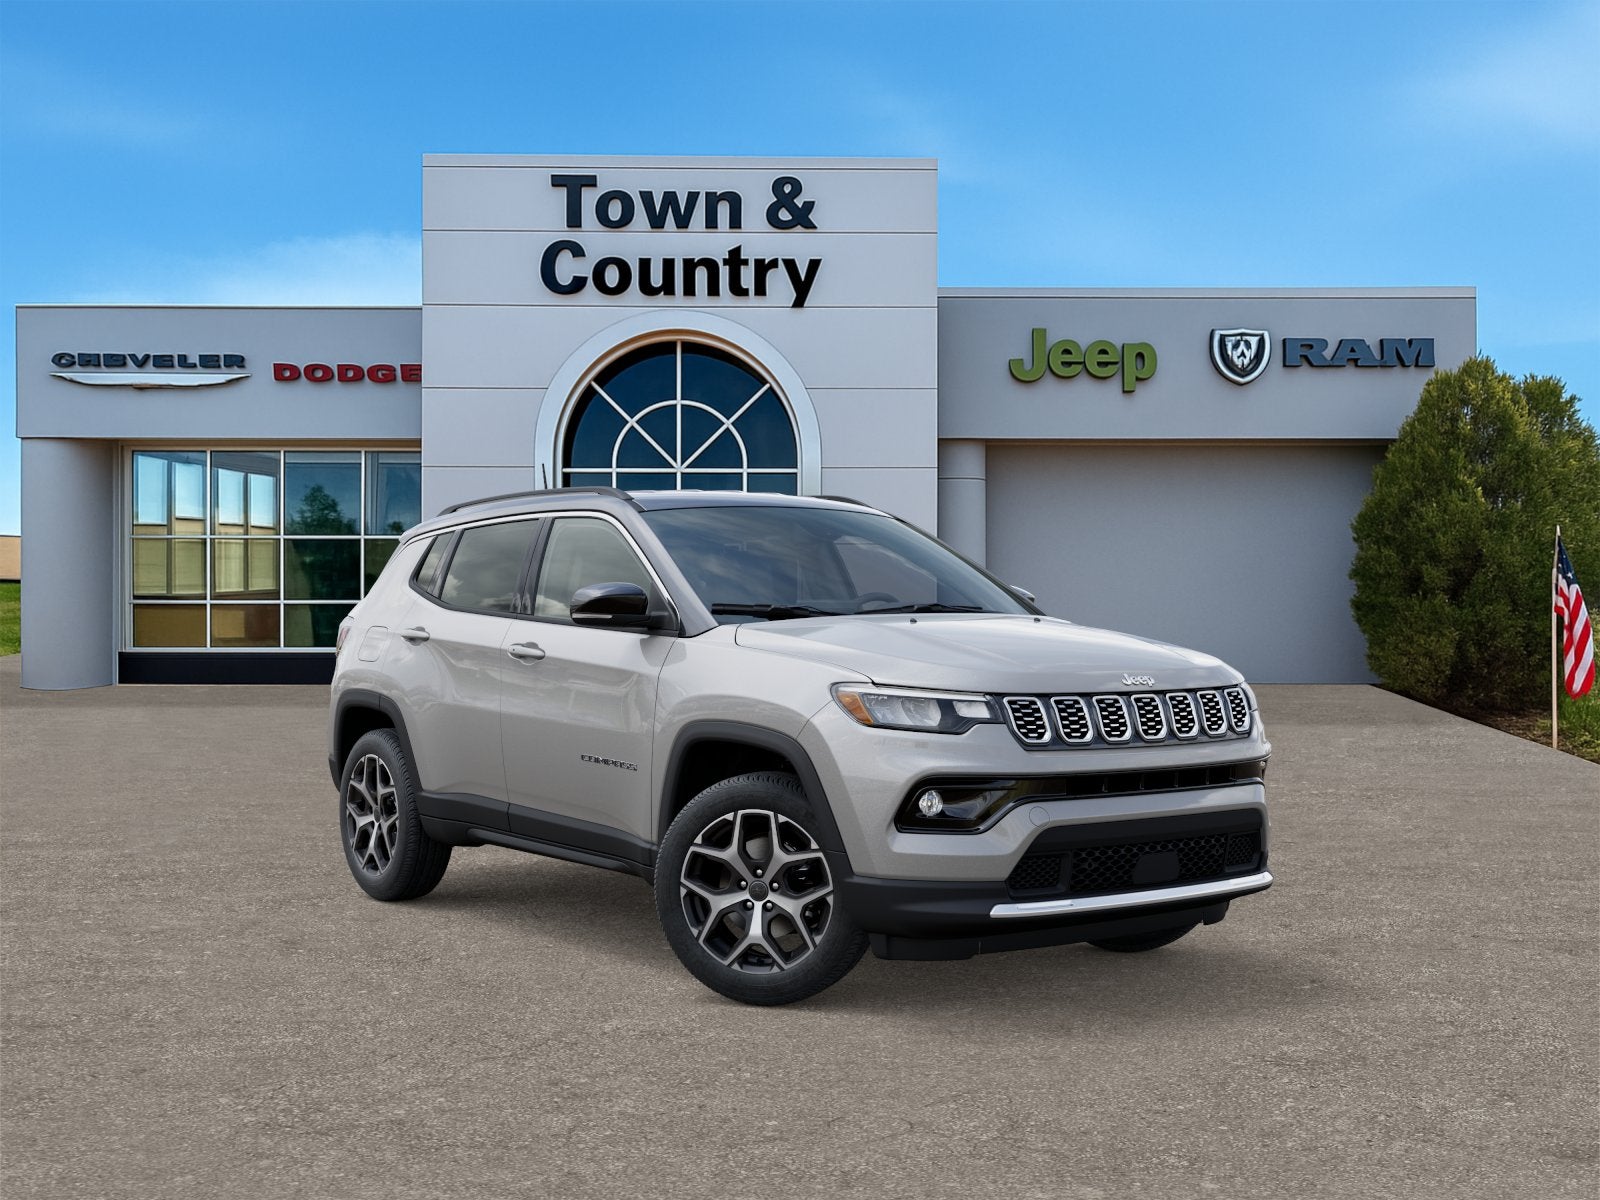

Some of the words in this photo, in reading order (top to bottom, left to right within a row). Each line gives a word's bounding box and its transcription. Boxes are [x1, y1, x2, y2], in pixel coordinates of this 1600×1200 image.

[550, 174, 743, 229] Town
[766, 176, 818, 230] &
[540, 239, 822, 308] Country
[273, 362, 421, 382] DODGE
[1009, 327, 1157, 392] Jeep
[1282, 337, 1435, 367] RAM
[1121, 673, 1155, 687] Jeep
